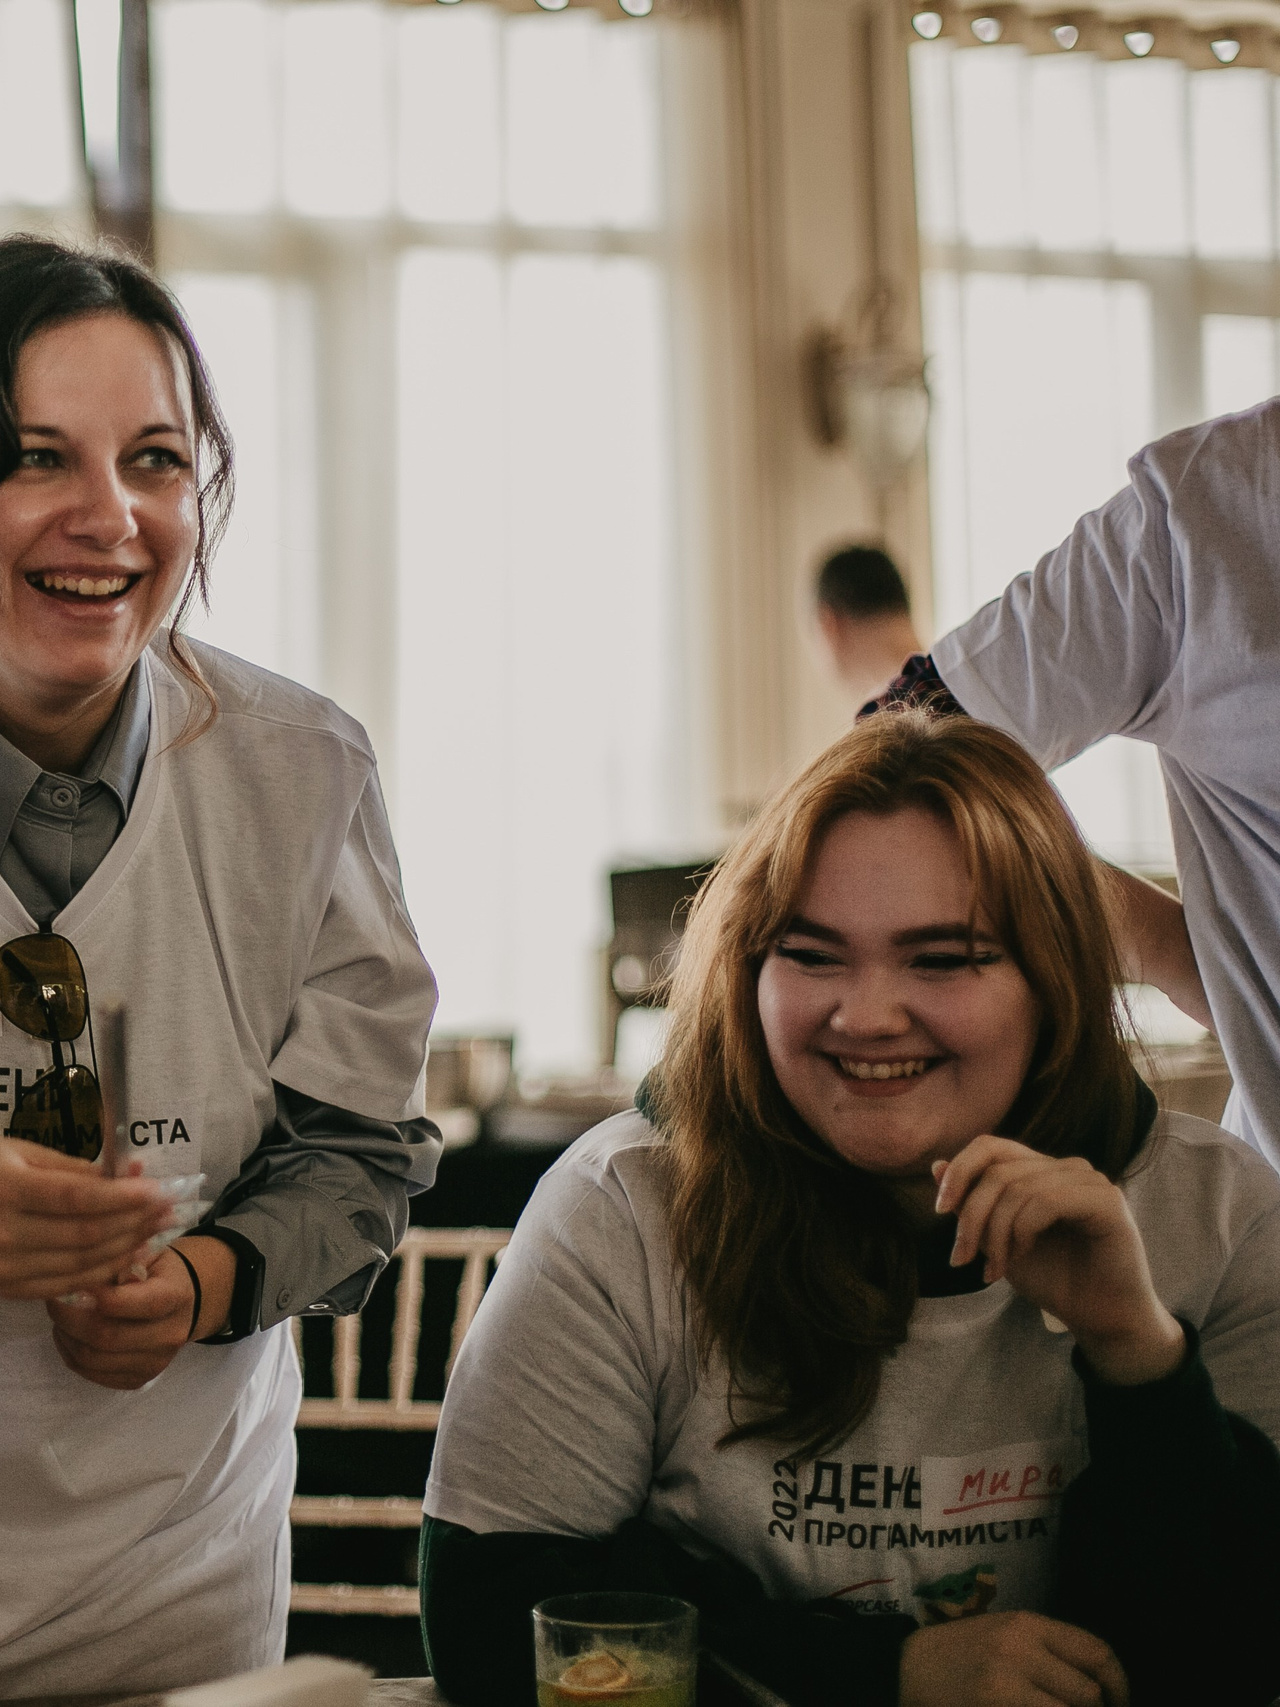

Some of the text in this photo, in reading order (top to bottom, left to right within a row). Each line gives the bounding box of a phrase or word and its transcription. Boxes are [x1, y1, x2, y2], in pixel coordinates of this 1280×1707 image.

[768, 1460, 798, 1542] 2022
[804, 1460, 921, 1514] ДЕНЬ
[804, 1517, 1049, 1550] ПРОГАММИСТА
